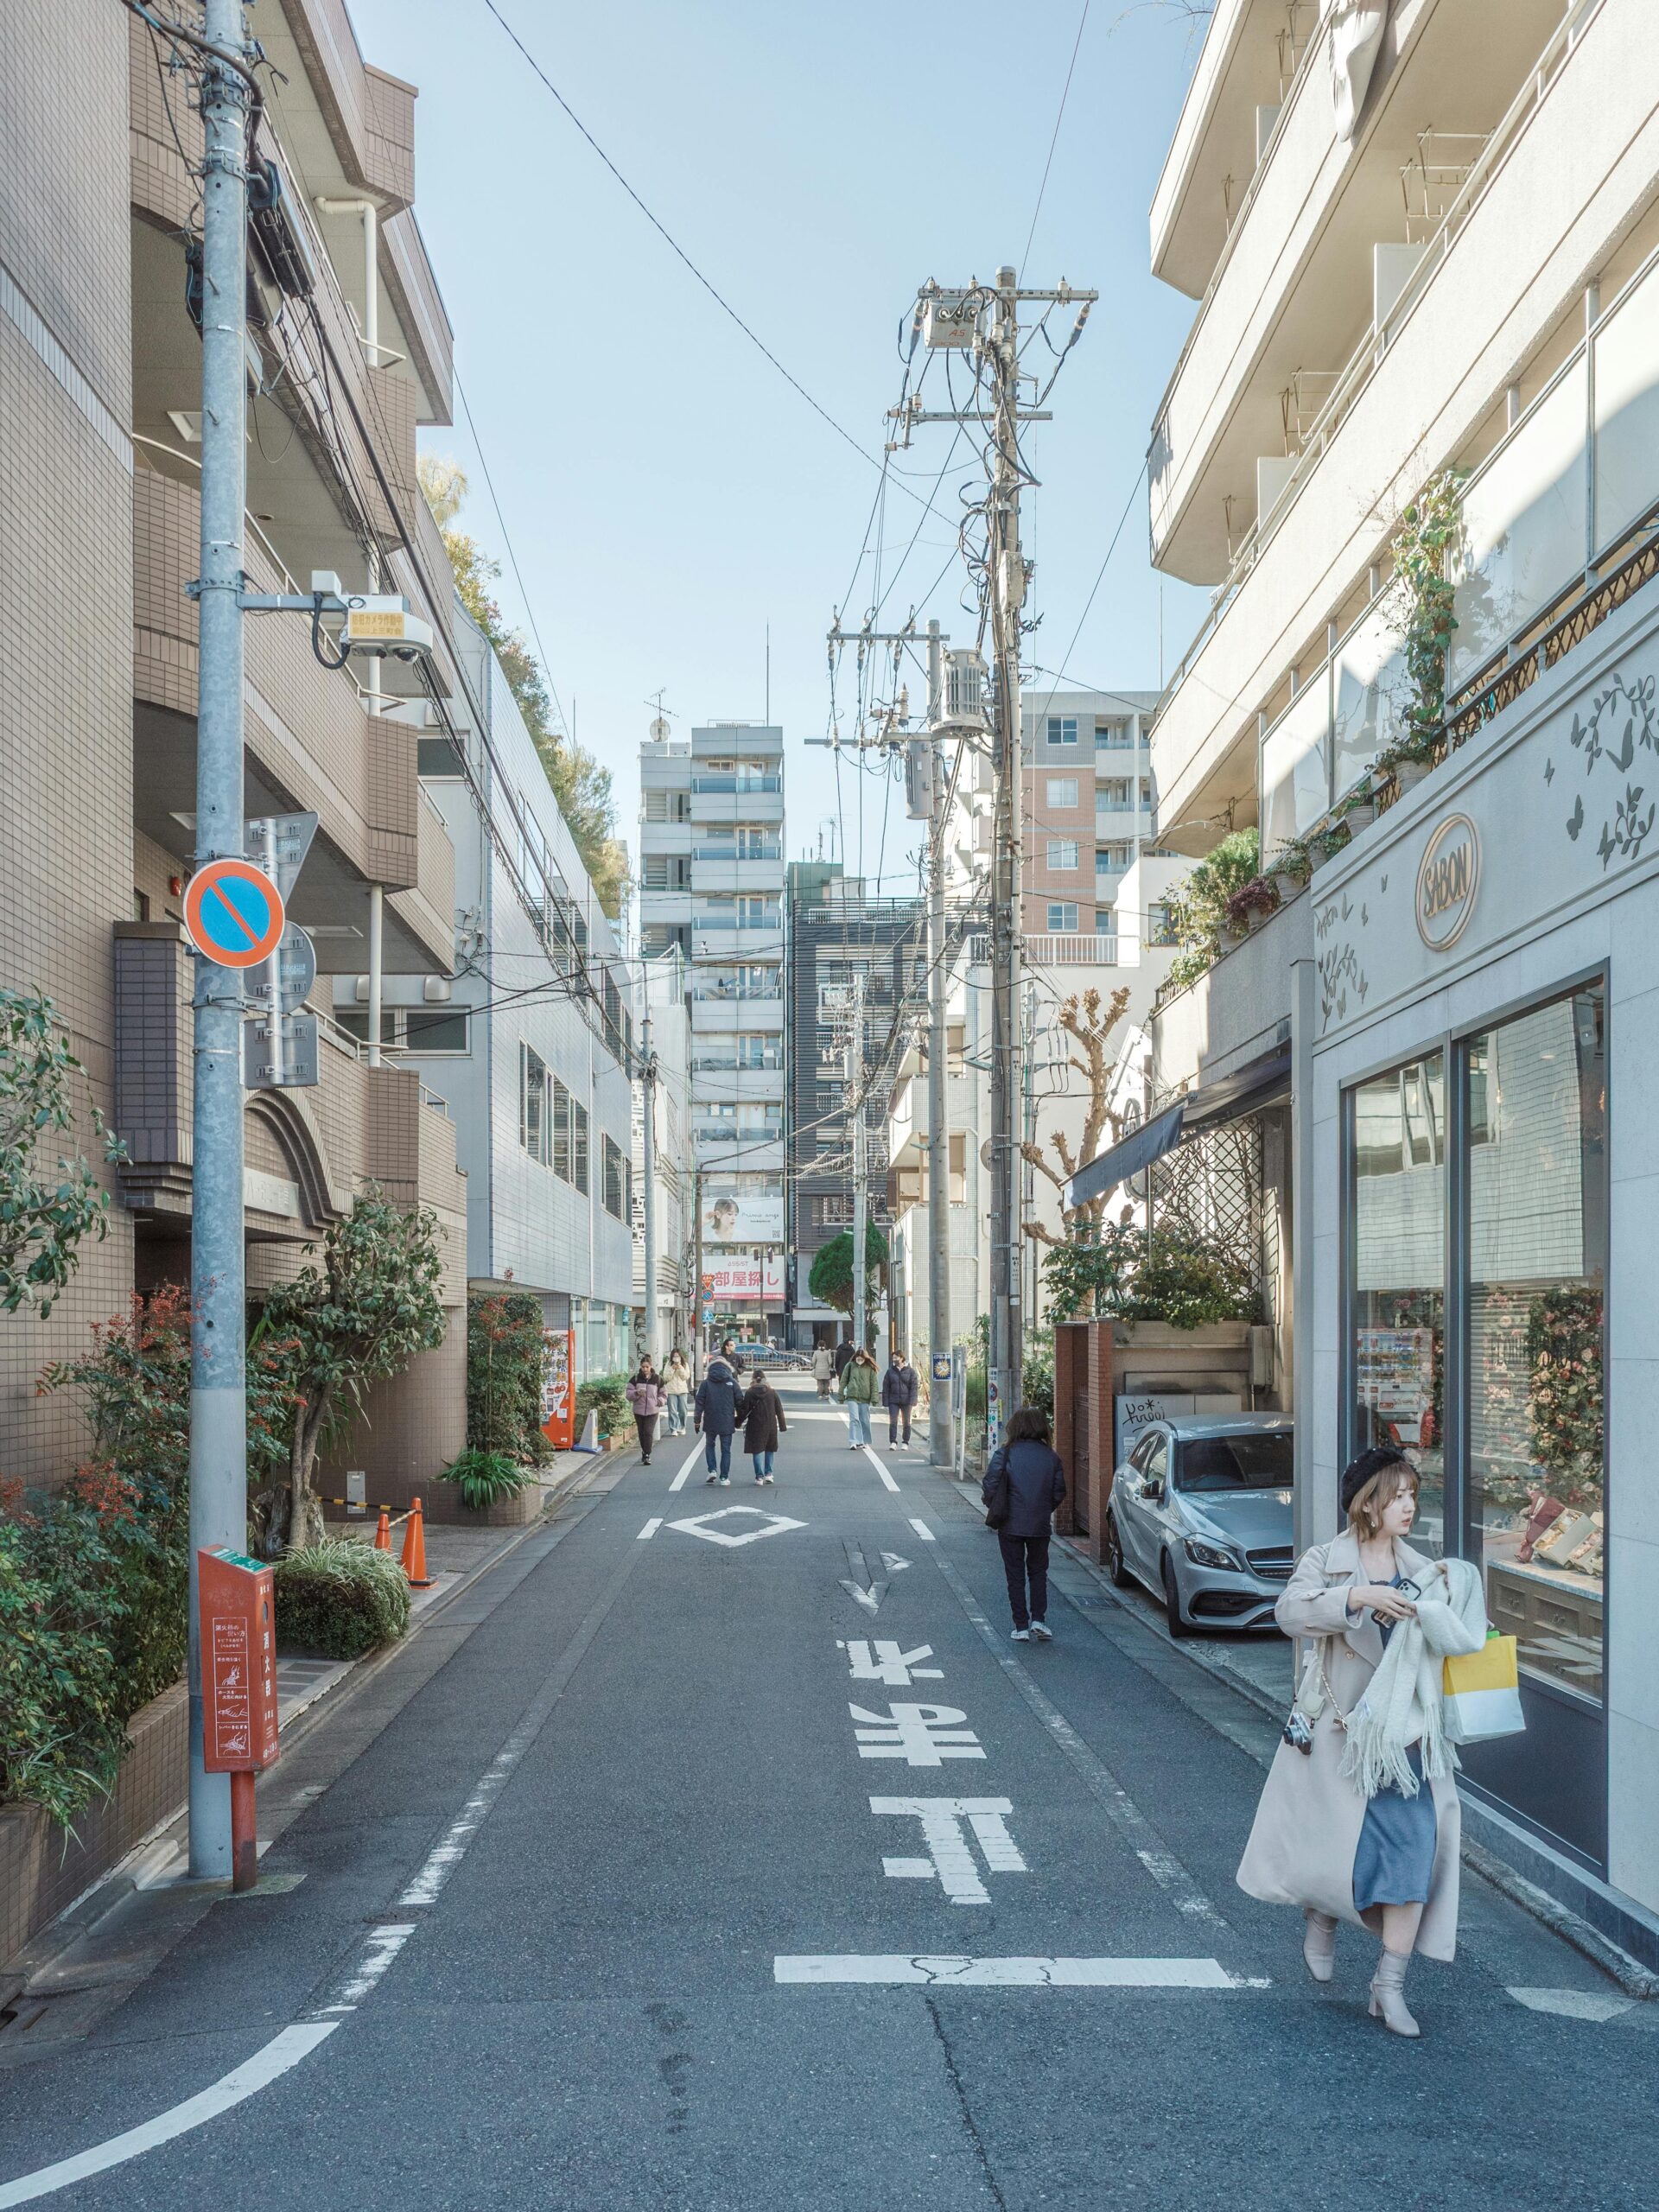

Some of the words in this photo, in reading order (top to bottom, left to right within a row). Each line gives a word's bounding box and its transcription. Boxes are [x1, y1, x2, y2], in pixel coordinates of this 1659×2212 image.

[1424, 842, 1467, 918] SABON
[702, 1271, 779, 1287] 部屋探し
[263, 1630, 271, 1698] 消火器
